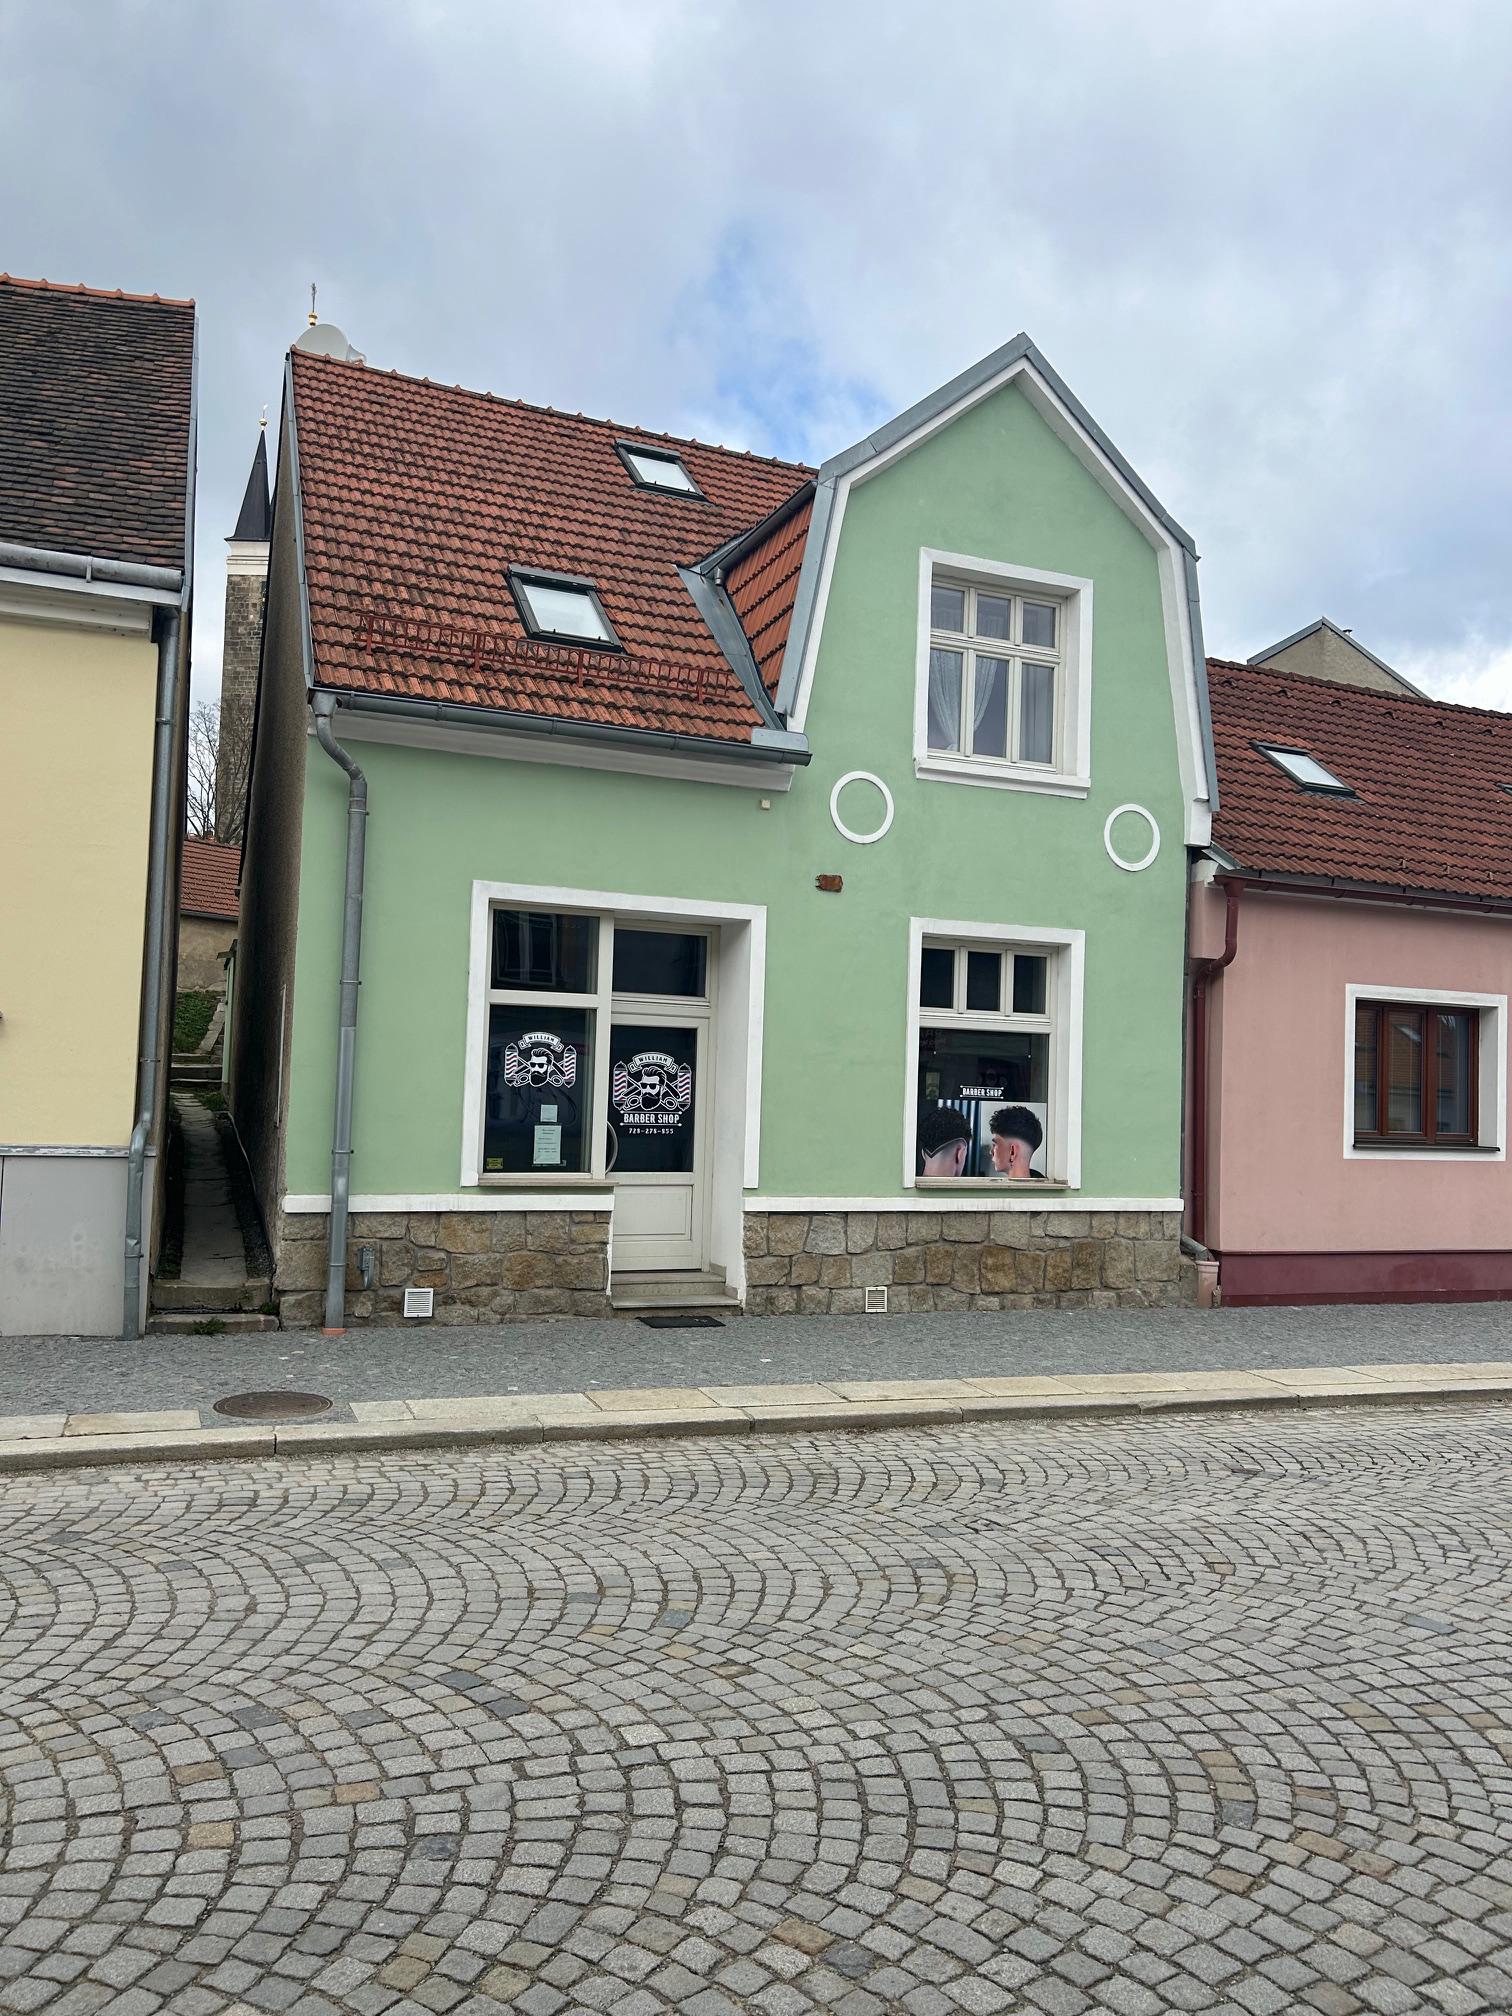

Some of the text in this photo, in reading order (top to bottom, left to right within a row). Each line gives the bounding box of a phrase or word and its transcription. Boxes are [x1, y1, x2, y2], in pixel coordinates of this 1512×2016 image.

[528, 1034, 555, 1042] WILLIAM
[638, 1055, 668, 1064] WILLIAM
[963, 1087, 1003, 1097] BARBER SHOP
[623, 1113, 680, 1124] BARBER SHOP
